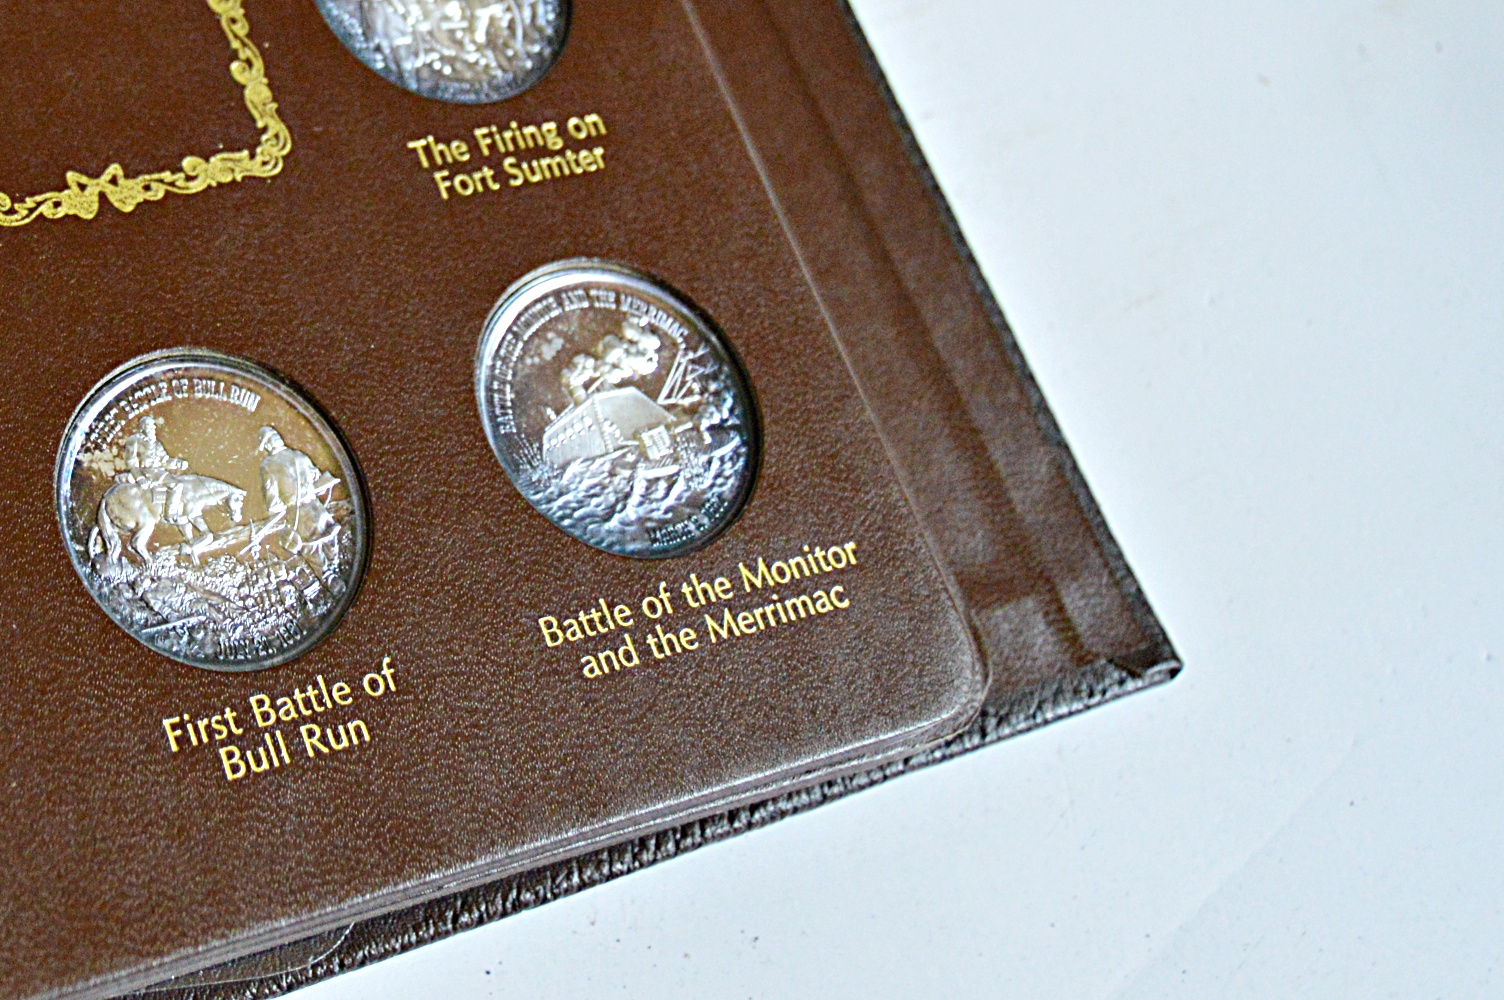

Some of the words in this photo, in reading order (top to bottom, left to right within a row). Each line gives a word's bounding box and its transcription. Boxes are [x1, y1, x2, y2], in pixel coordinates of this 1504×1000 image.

[406, 135, 471, 169] The
[473, 120, 564, 157] Firing
[566, 112, 607, 140] on
[433, 167, 501, 201] Fort
[502, 146, 607, 187] Sumter
[172, 378, 189, 398] OF
[193, 378, 228, 401] BULL
[229, 384, 261, 413] RUN
[492, 380, 516, 434] BATTLE
[538, 599, 635, 649] Battle
[642, 581, 675, 619] of
[681, 572, 735, 610] the
[738, 541, 859, 593] Monitor
[581, 632, 641, 680] and
[646, 619, 699, 660] the
[704, 583, 851, 644] Merrimac
[162, 706, 244, 753] First
[249, 674, 354, 729] Battle
[363, 656, 398, 697] of
[220, 729, 292, 781] Bull
[300, 717, 371, 759] Run
